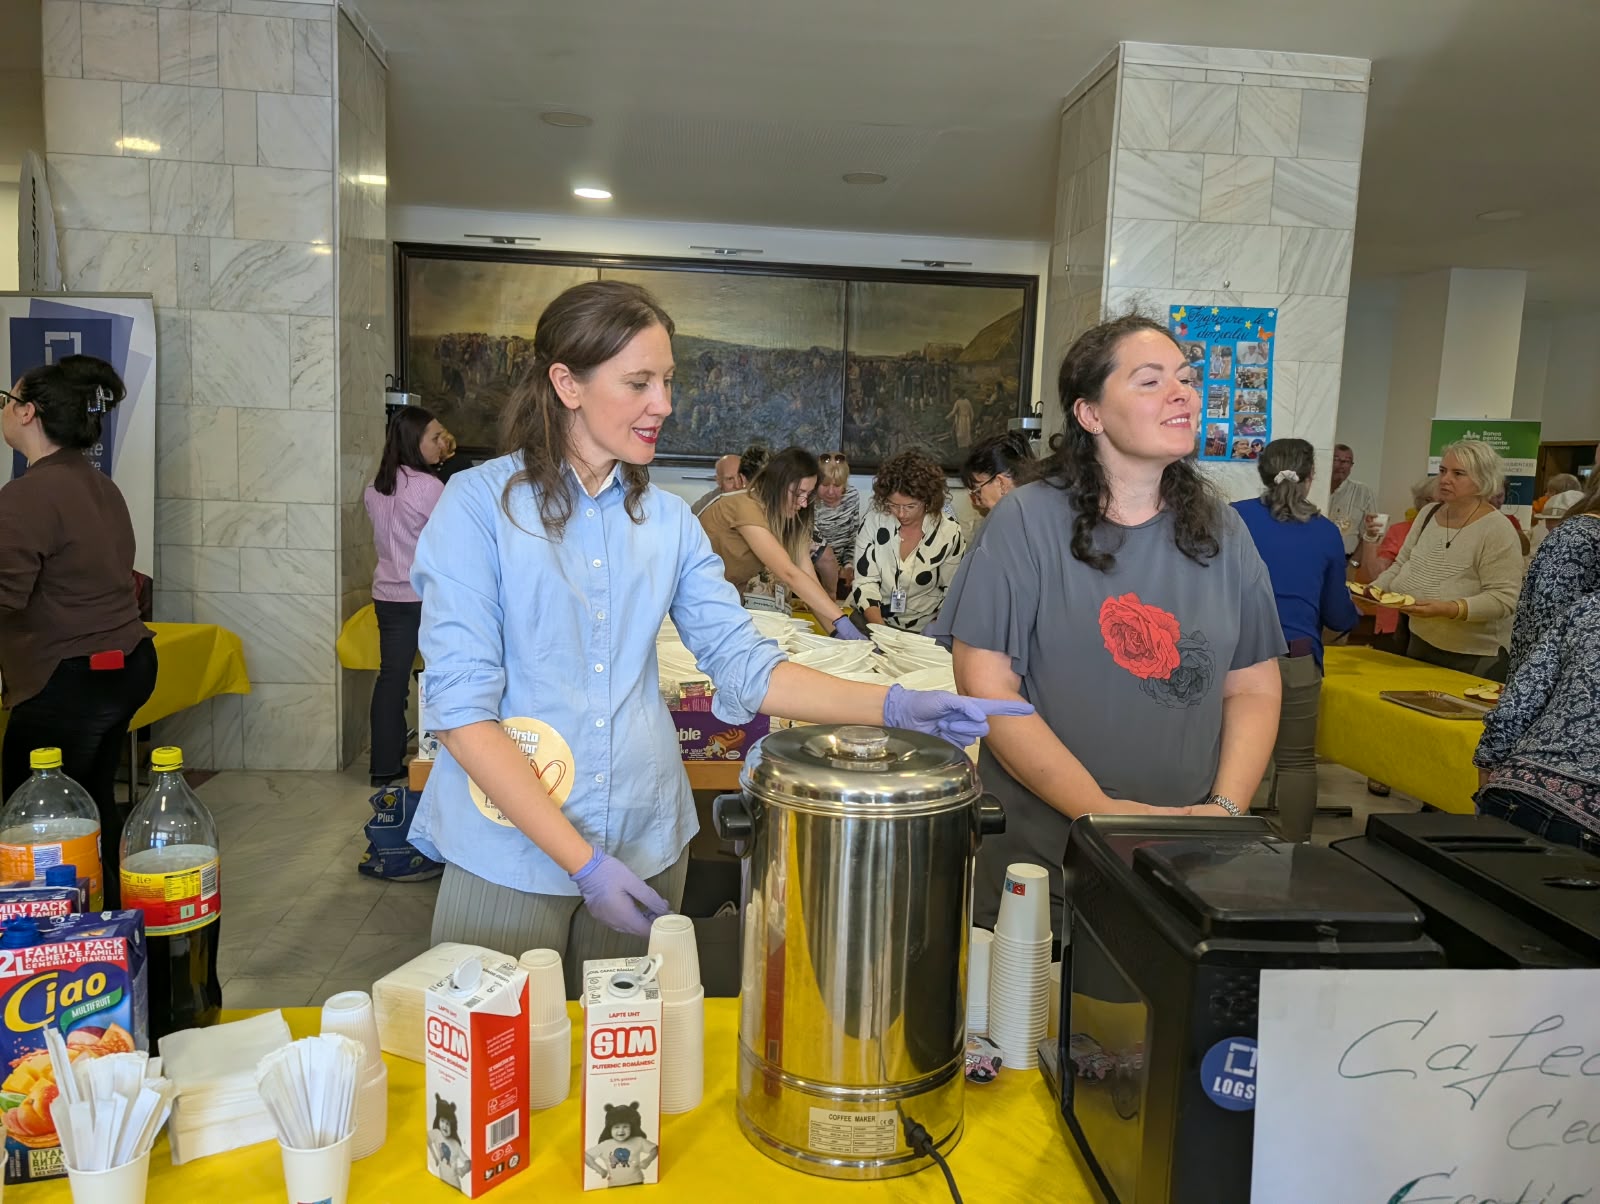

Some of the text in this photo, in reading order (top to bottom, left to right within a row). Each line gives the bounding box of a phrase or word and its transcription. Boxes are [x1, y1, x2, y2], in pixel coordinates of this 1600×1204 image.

[377, 812, 395, 823] Plus
[32, 901, 68, 912] PACK
[25, 939, 124, 958] FAMILY PACK
[25, 953, 67, 964] PACHET
[84, 948, 124, 957] FAMILIE
[0, 950, 34, 979] 2L
[76, 954, 125, 964] ОПАКОВКА
[4, 971, 107, 1033] Ciao
[71, 995, 111, 1019] MULTIFRUIT
[608, 1011, 627, 1019] LAPTE
[427, 1015, 470, 1063] SIM
[590, 1025, 657, 1060] SIM
[592, 1060, 656, 1070] PUTERNIC ROMÂNESC
[1213, 1076, 1256, 1100] LOGS
[828, 1113, 876, 1123] COFFEE MAKER
